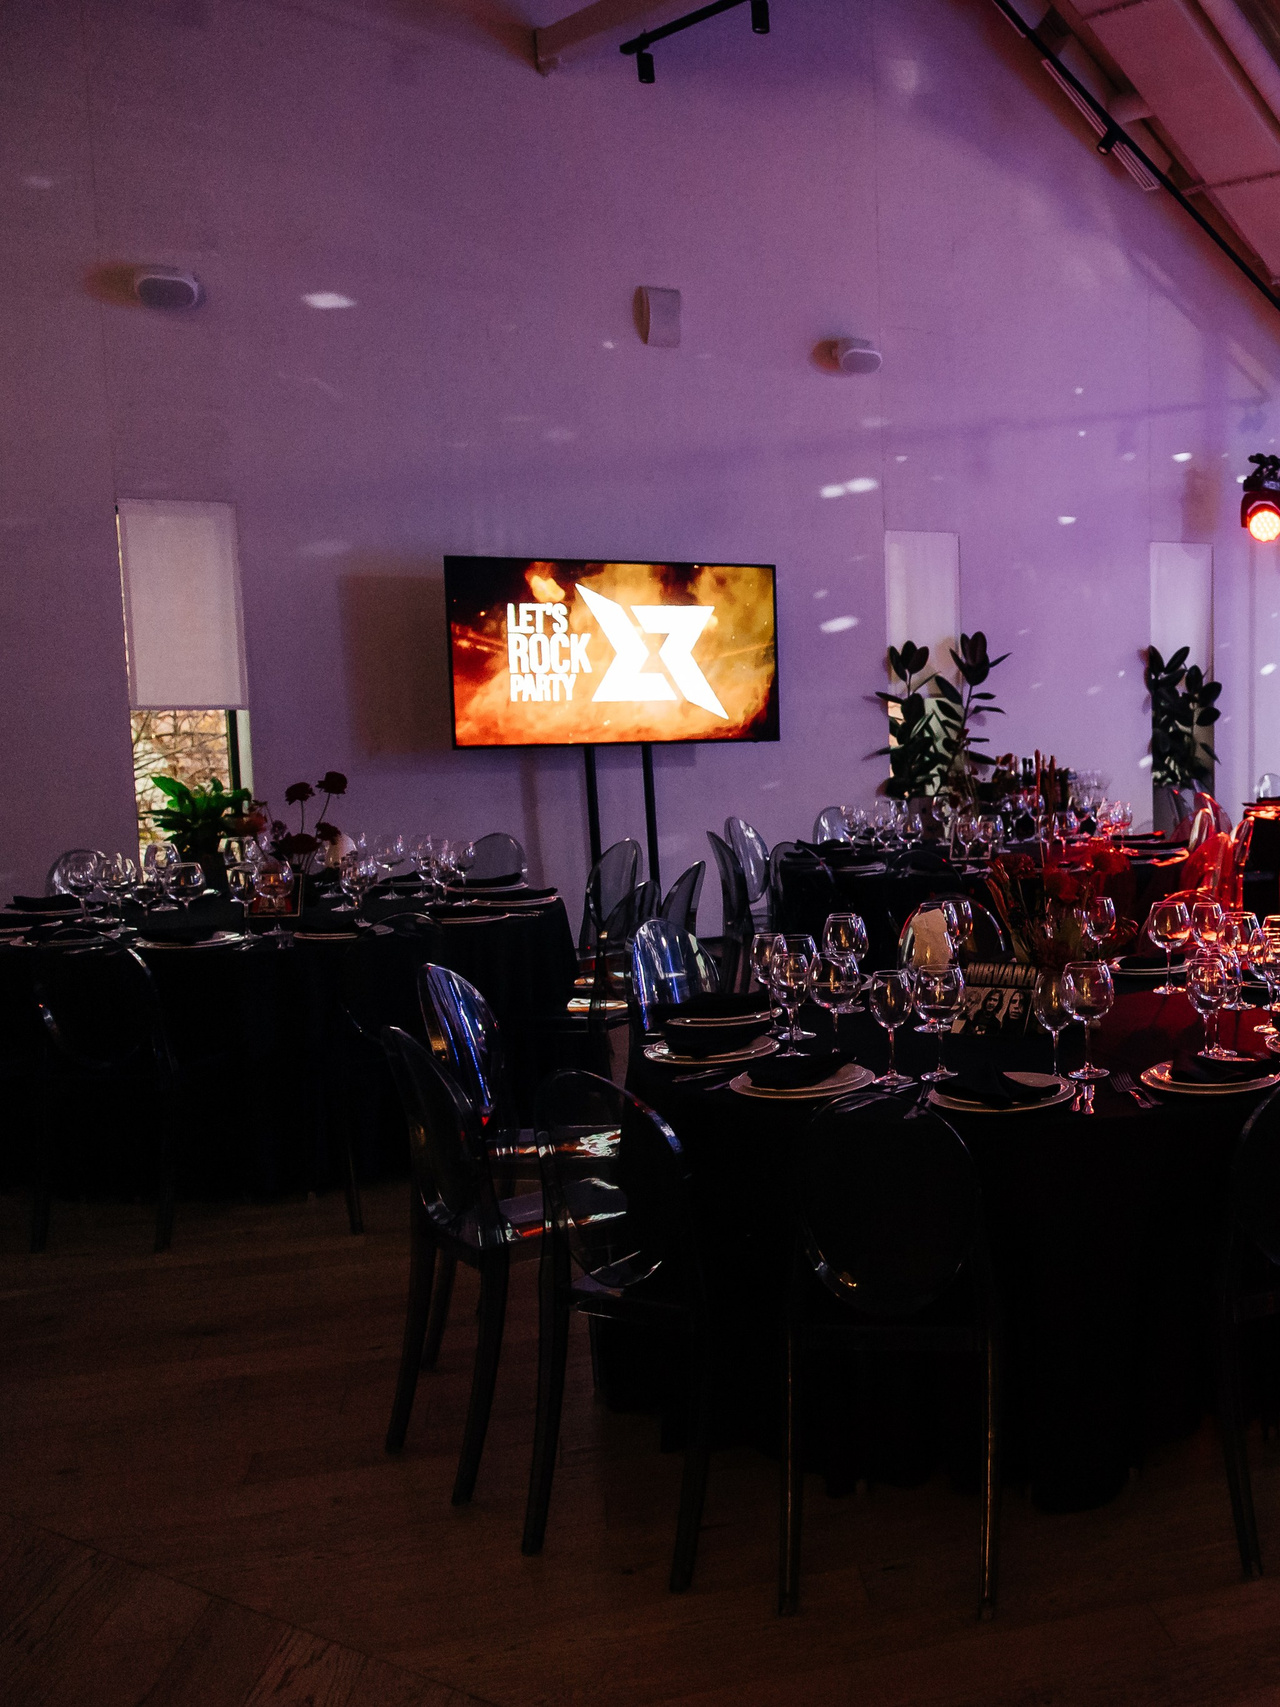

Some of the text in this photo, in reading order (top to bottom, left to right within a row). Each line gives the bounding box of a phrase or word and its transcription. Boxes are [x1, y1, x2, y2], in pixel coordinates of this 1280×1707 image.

[507, 602, 568, 634] LET'S
[508, 633, 593, 674] ROCK
[510, 673, 577, 702] PARTY
[966, 962, 1036, 987] NIRVANA
